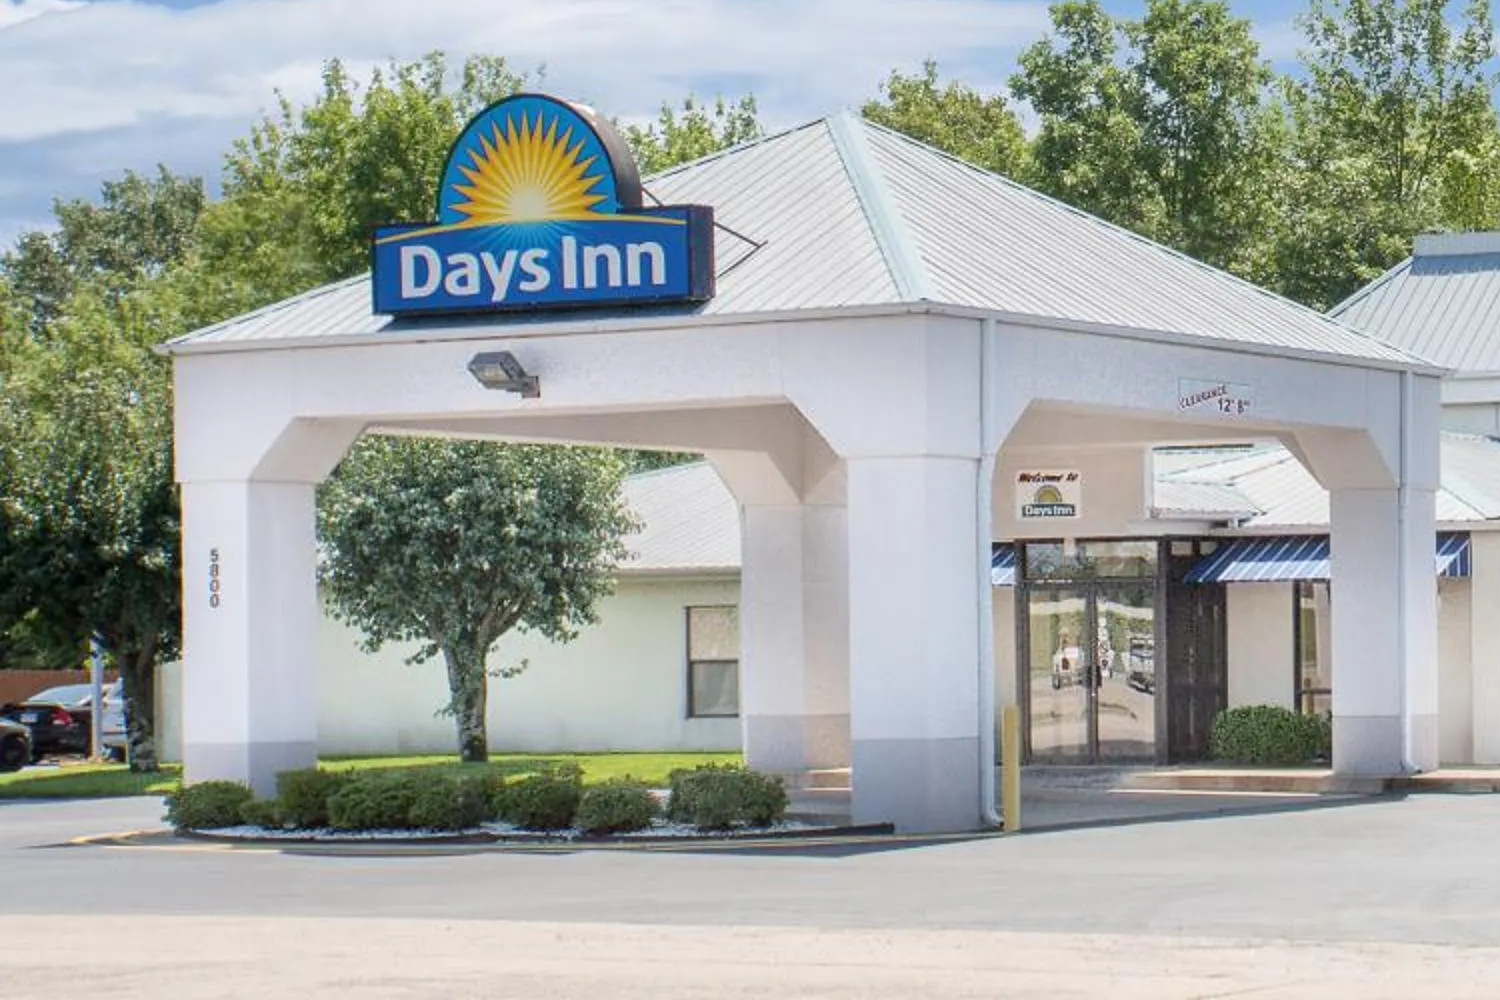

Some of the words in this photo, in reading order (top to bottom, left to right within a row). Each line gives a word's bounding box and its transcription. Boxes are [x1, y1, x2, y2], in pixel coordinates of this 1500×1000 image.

[401, 245, 551, 302] Days
[561, 235, 667, 290] Inn
[1025, 504, 1052, 516] Days
[1053, 504, 1073, 515] Inn
